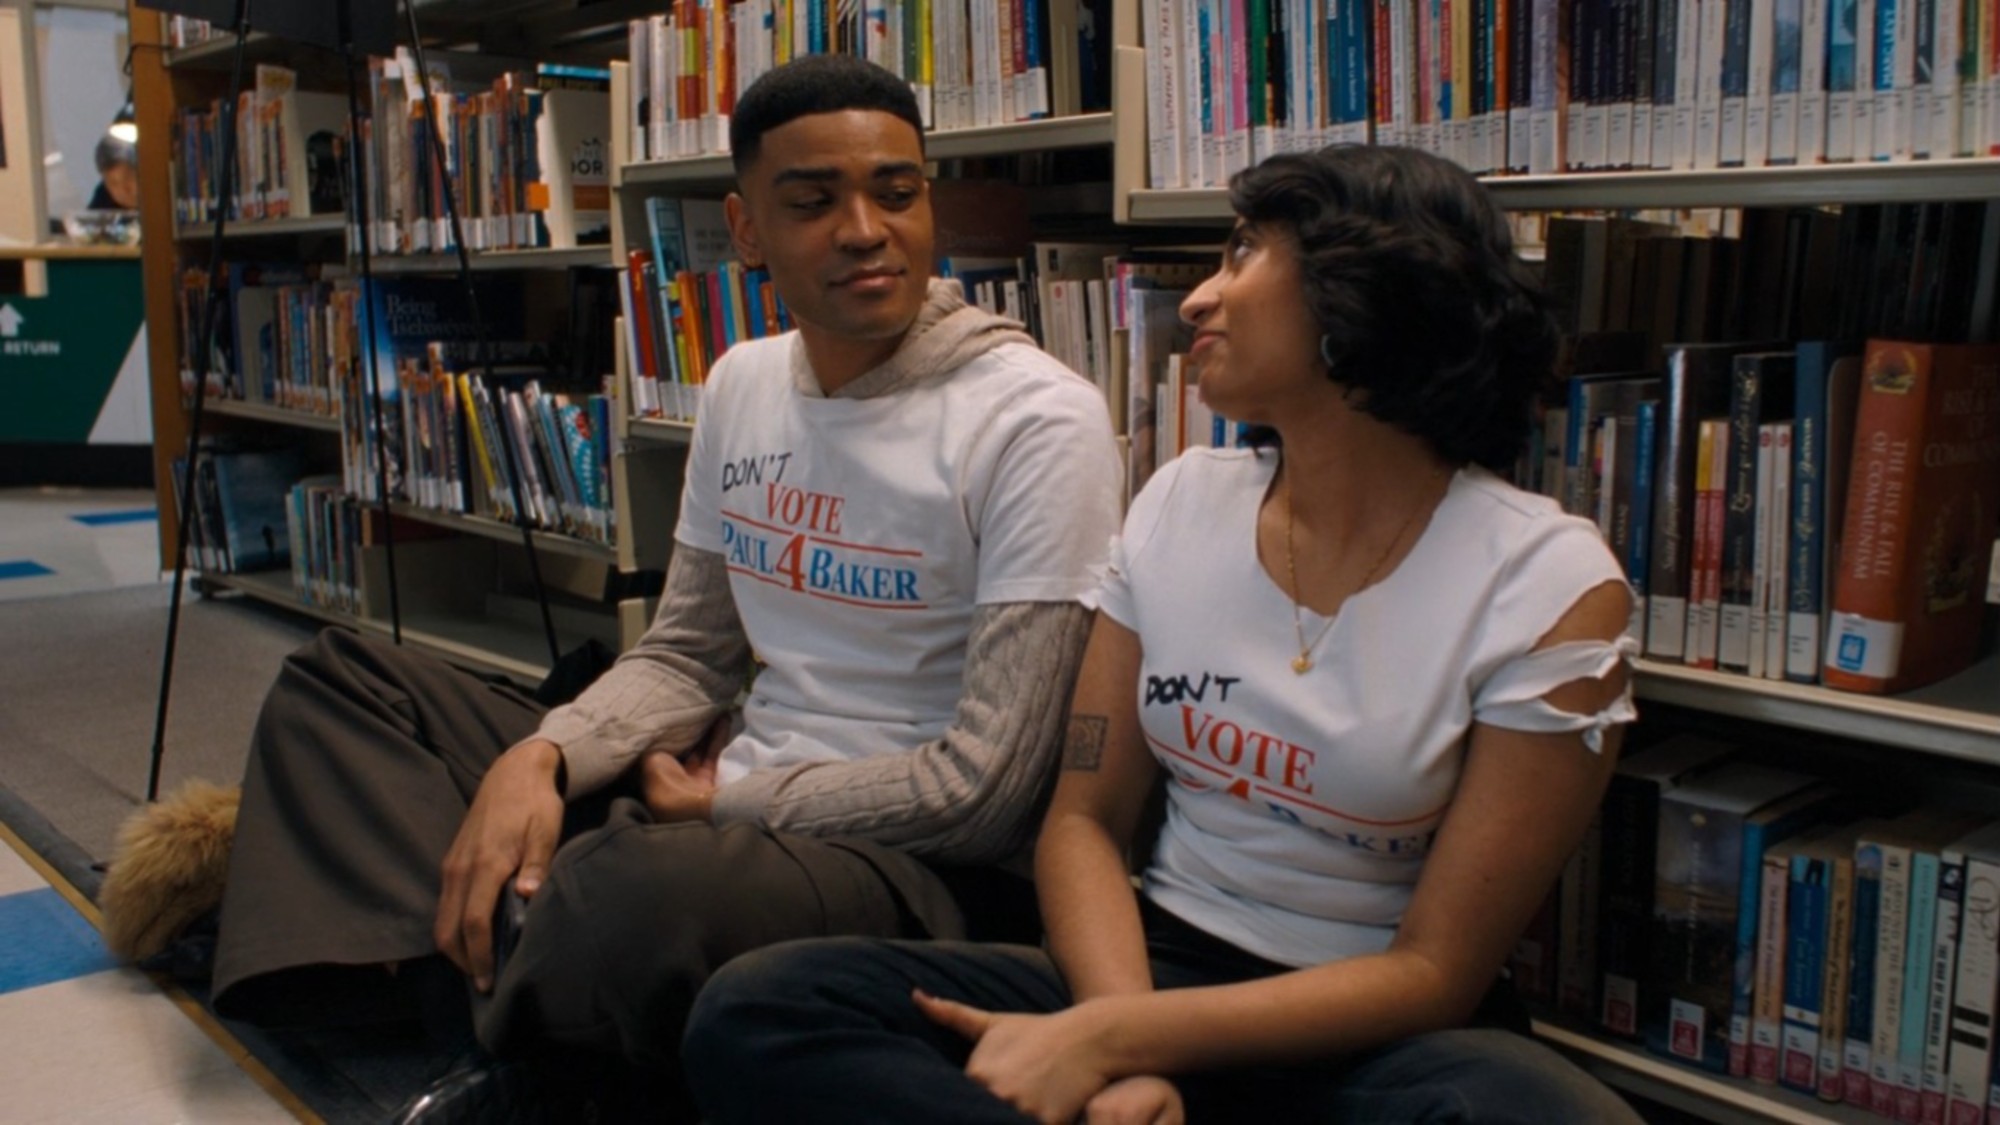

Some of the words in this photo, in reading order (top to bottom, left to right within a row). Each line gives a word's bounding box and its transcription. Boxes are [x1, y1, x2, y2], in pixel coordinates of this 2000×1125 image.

[4, 340, 61, 356] RETURN
[1870, 430, 1888, 456] OF
[1888, 438, 1909, 475] THE
[721, 451, 793, 493] DON'T
[766, 482, 845, 535] VOTE
[1881, 480, 1904, 517] RISE
[1851, 459, 1884, 580] COMMUNISM
[1879, 521, 1898, 535] &
[721, 521, 775, 576] PAUL
[775, 533, 809, 594] 4
[1873, 539, 1896, 577] FALL
[1144, 671, 1242, 707] DON'T
[1180, 703, 1316, 796] VOTE
[1890, 880, 1906, 940] AROUND
[1888, 945, 1902, 971] THE
[1885, 976, 1901, 1026] WORLD
